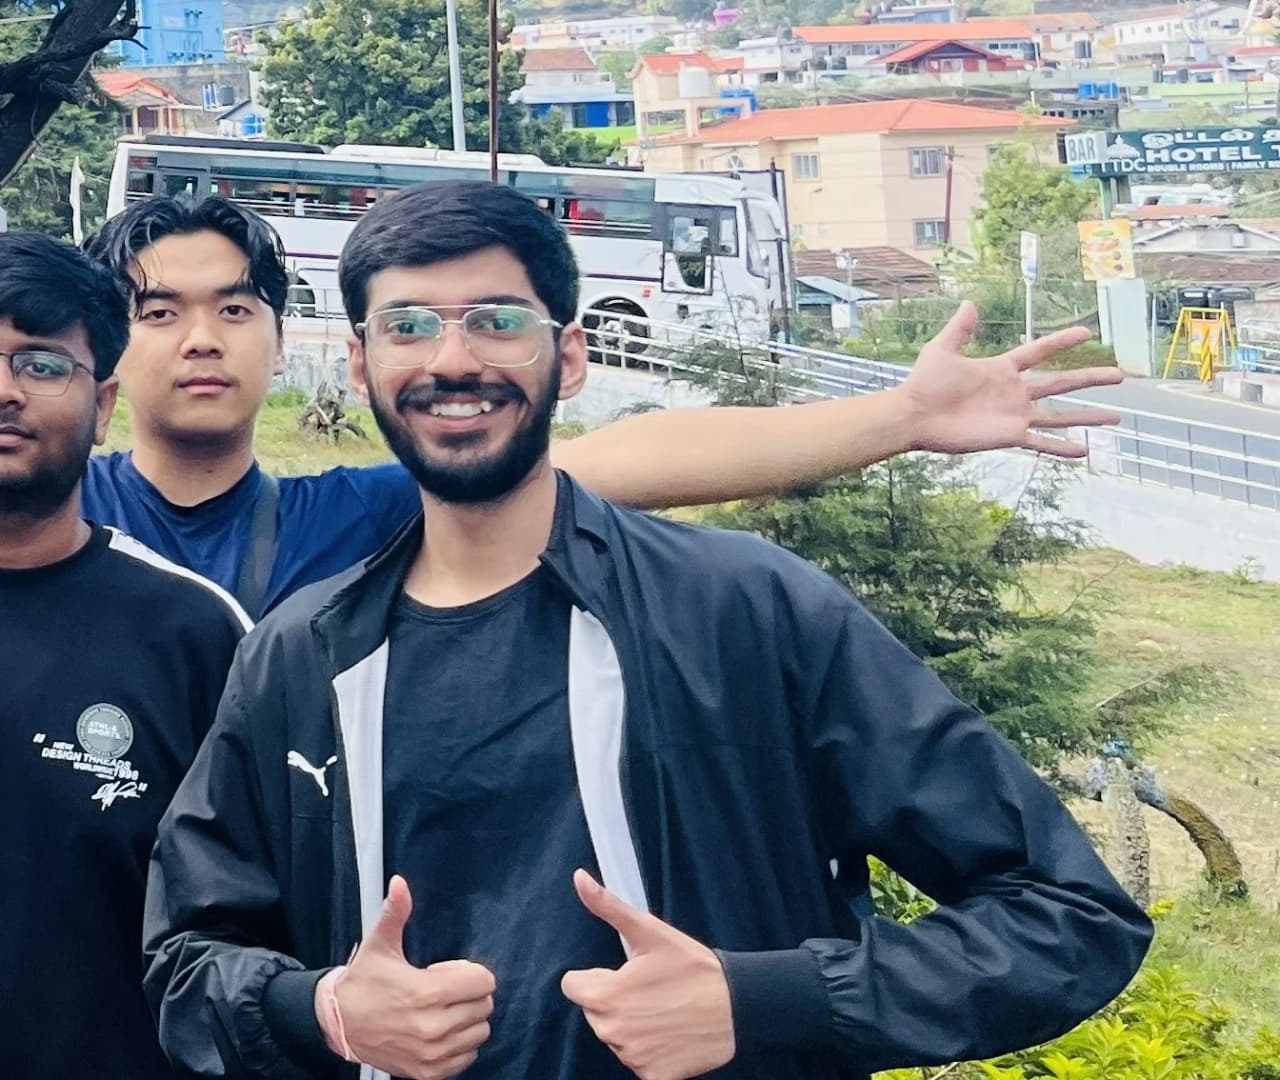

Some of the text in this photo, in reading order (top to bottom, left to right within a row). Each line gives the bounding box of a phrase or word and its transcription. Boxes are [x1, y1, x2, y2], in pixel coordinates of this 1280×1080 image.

[1068, 136, 1097, 162] BAR
[1145, 145, 1262, 163] HOTEL
[1147, 164, 1187, 173] DOUBLE
[1231, 160, 1266, 170] FAMILY
[41, 747, 83, 762] DESIGN
[82, 753, 133, 771] THREADS
